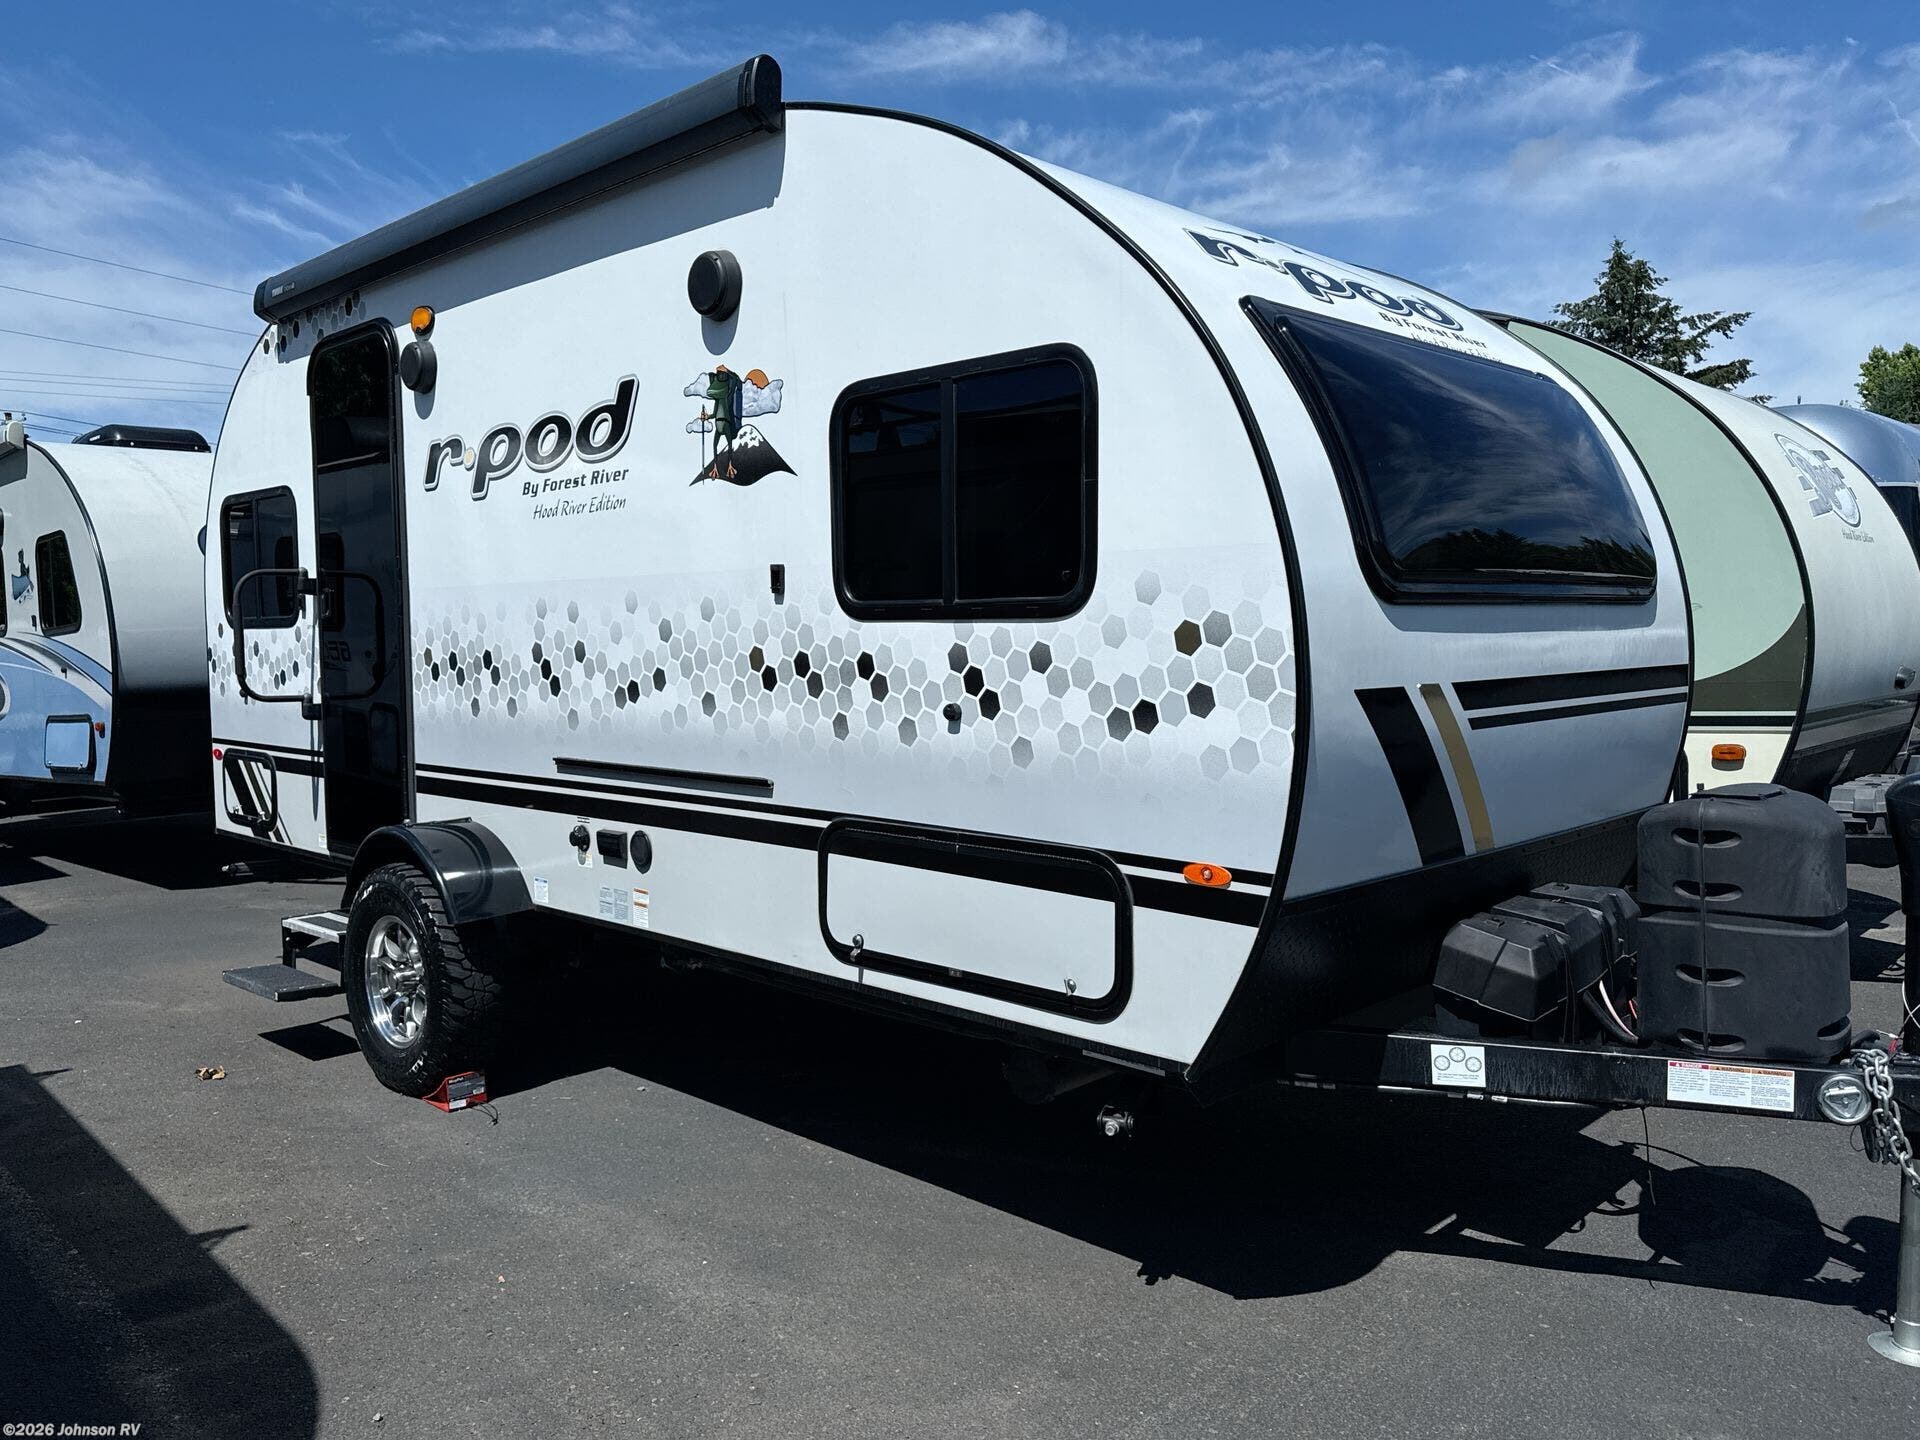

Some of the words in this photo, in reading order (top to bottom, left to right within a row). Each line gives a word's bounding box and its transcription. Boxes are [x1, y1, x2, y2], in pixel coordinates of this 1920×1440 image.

[1378, 311, 1403, 327] By
[1402, 319, 1452, 338] Forest
[1451, 332, 1488, 349] River
[522, 481, 539, 497] By
[542, 473, 587, 493] Forest
[590, 469, 629, 485] River
[533, 499, 560, 519] Hood
[561, 500, 587, 516] River
[588, 493, 626, 513] Edition
